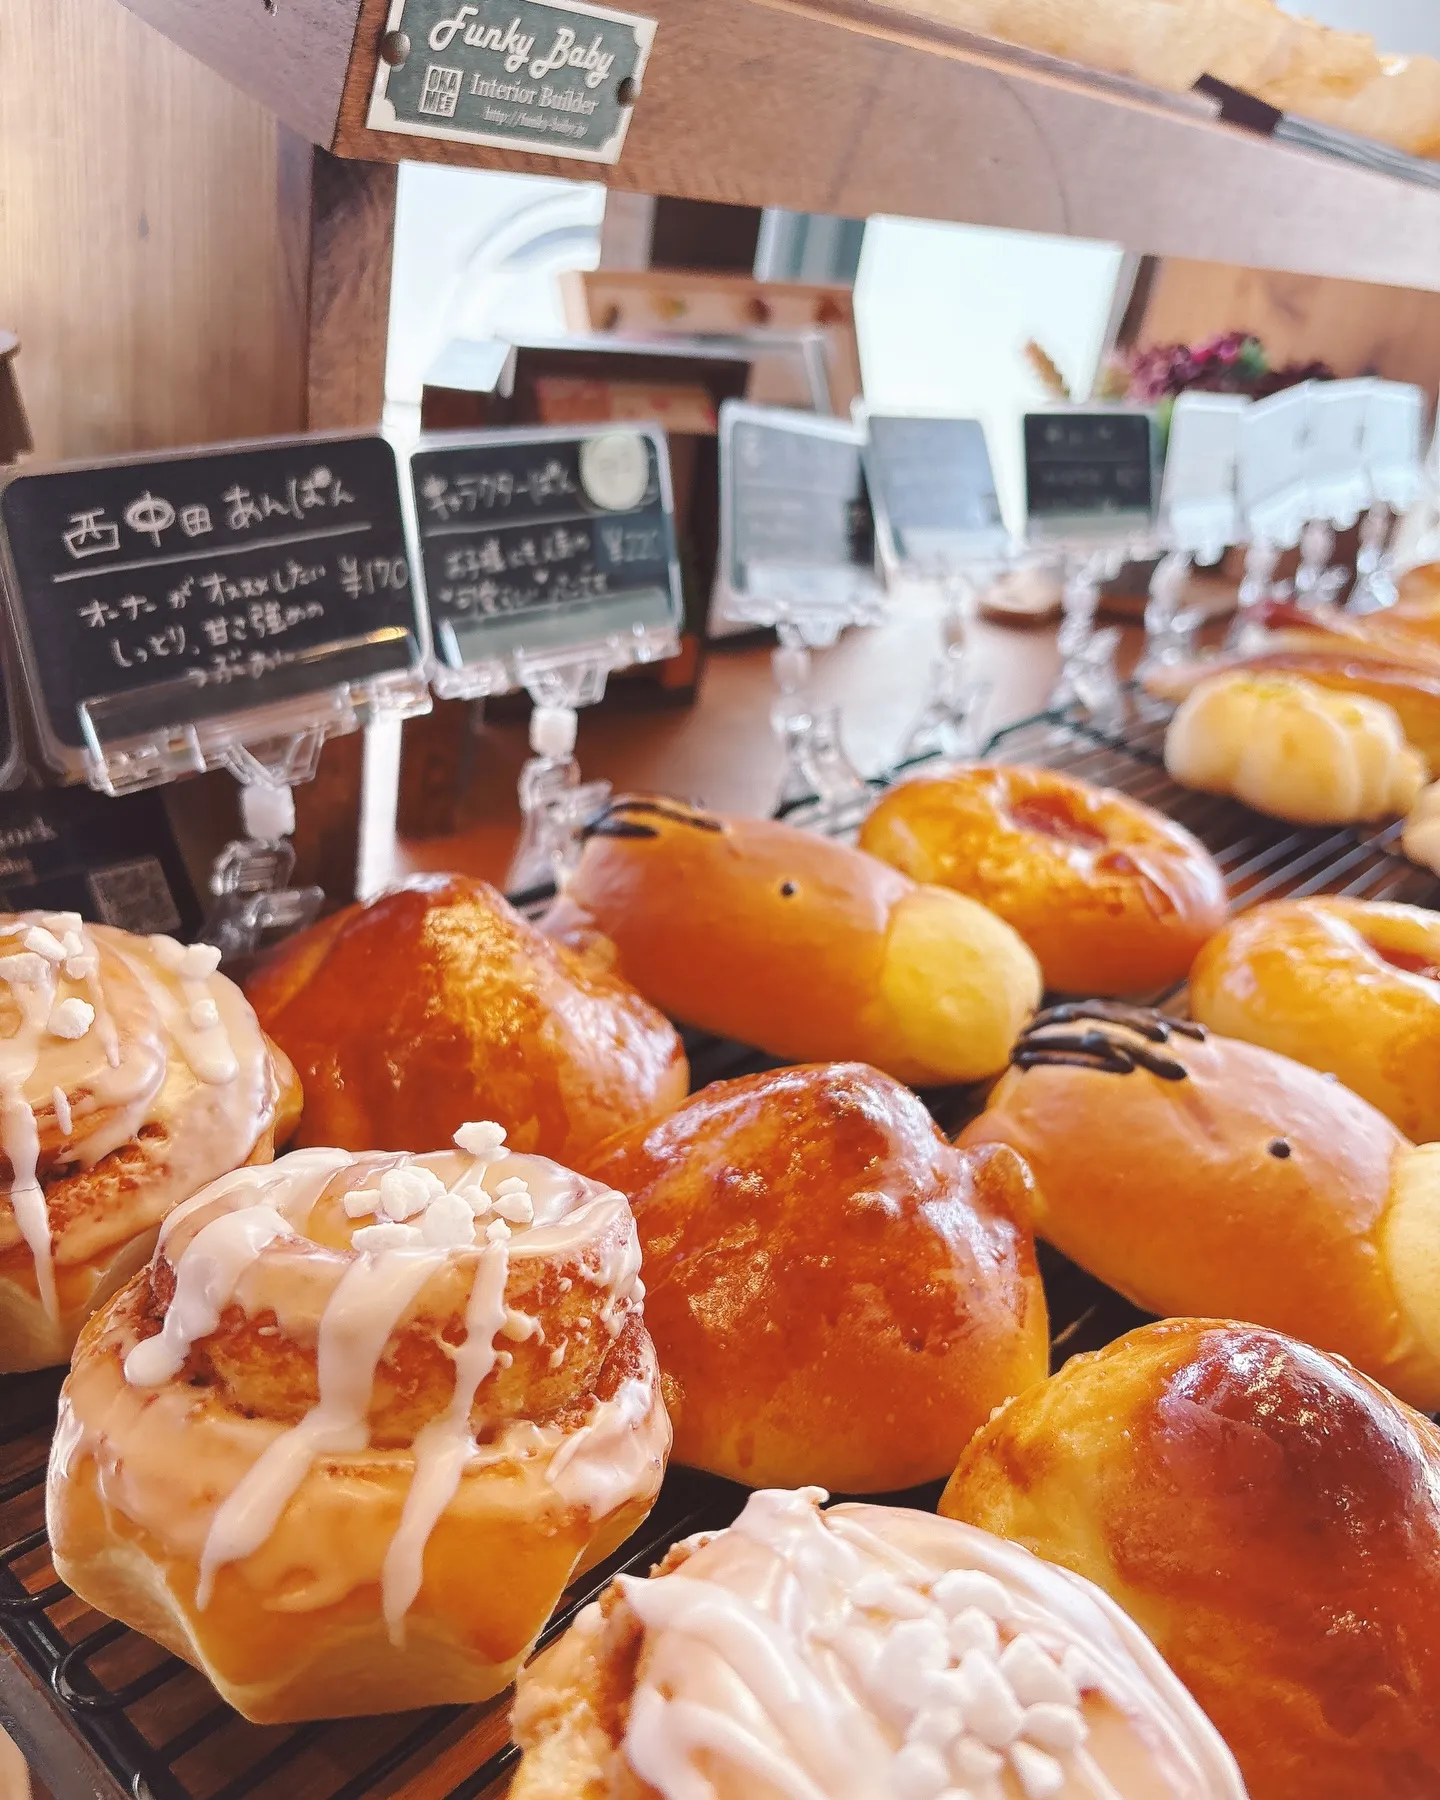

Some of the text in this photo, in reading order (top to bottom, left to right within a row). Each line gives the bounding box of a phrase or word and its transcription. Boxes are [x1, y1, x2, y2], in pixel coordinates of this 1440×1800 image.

[429, 6, 615, 89] Funky Baby
[470, 73, 599, 115] Interior Builder
[338, 554, 408, 599] ¥170
